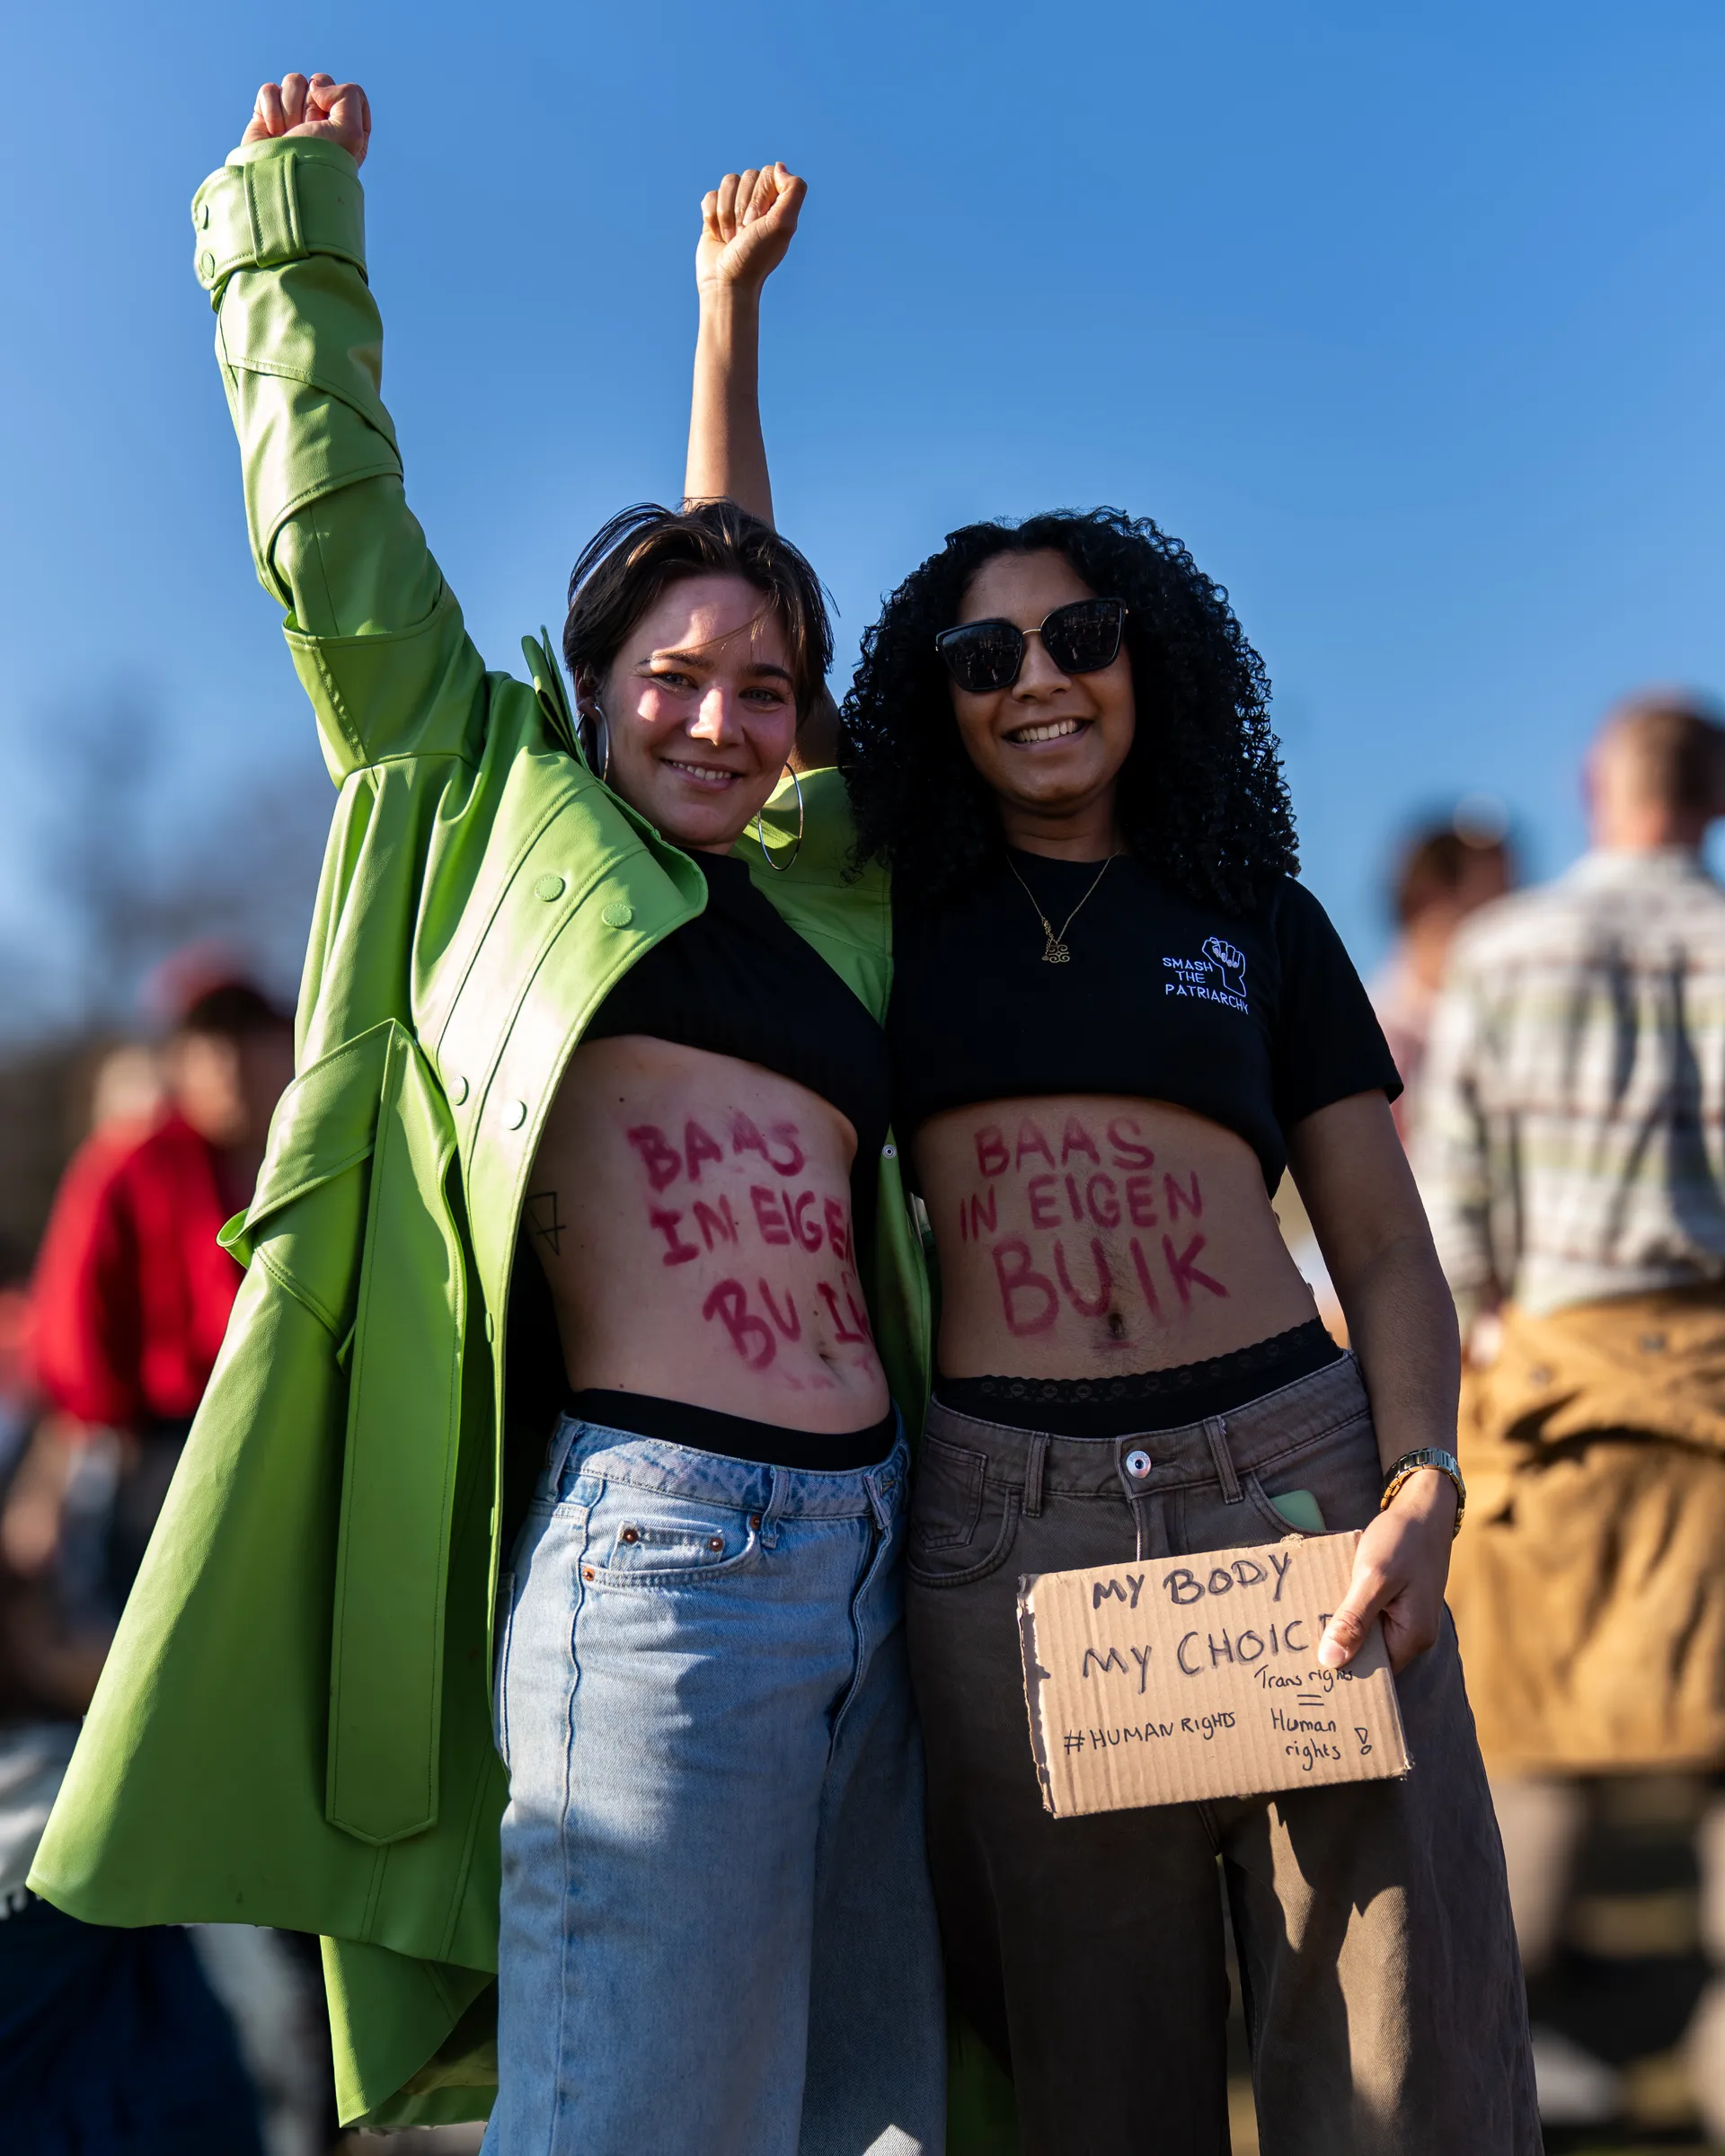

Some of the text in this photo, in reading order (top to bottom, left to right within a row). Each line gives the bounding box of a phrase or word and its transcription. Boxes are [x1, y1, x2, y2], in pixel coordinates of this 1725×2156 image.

[1162, 957, 1213, 972] SMASH
[1175, 970, 1206, 984] THE
[1165, 984, 1249, 1015] PATRIARCHY
[627, 1109, 805, 1192] BAAS
[973, 1115, 1155, 1179] BAAS
[650, 1194, 739, 1267] IN
[960, 1171, 1203, 1242] IN EIGEN
[992, 1232, 1231, 1338] BUIK
[1092, 1552, 1293, 1610] MY BODY
[1082, 1644, 1153, 1694] MY
[1254, 1664, 1303, 1689] Trans
[1270, 1707, 1337, 1733] Human
[1285, 1737, 1341, 1772] rights
